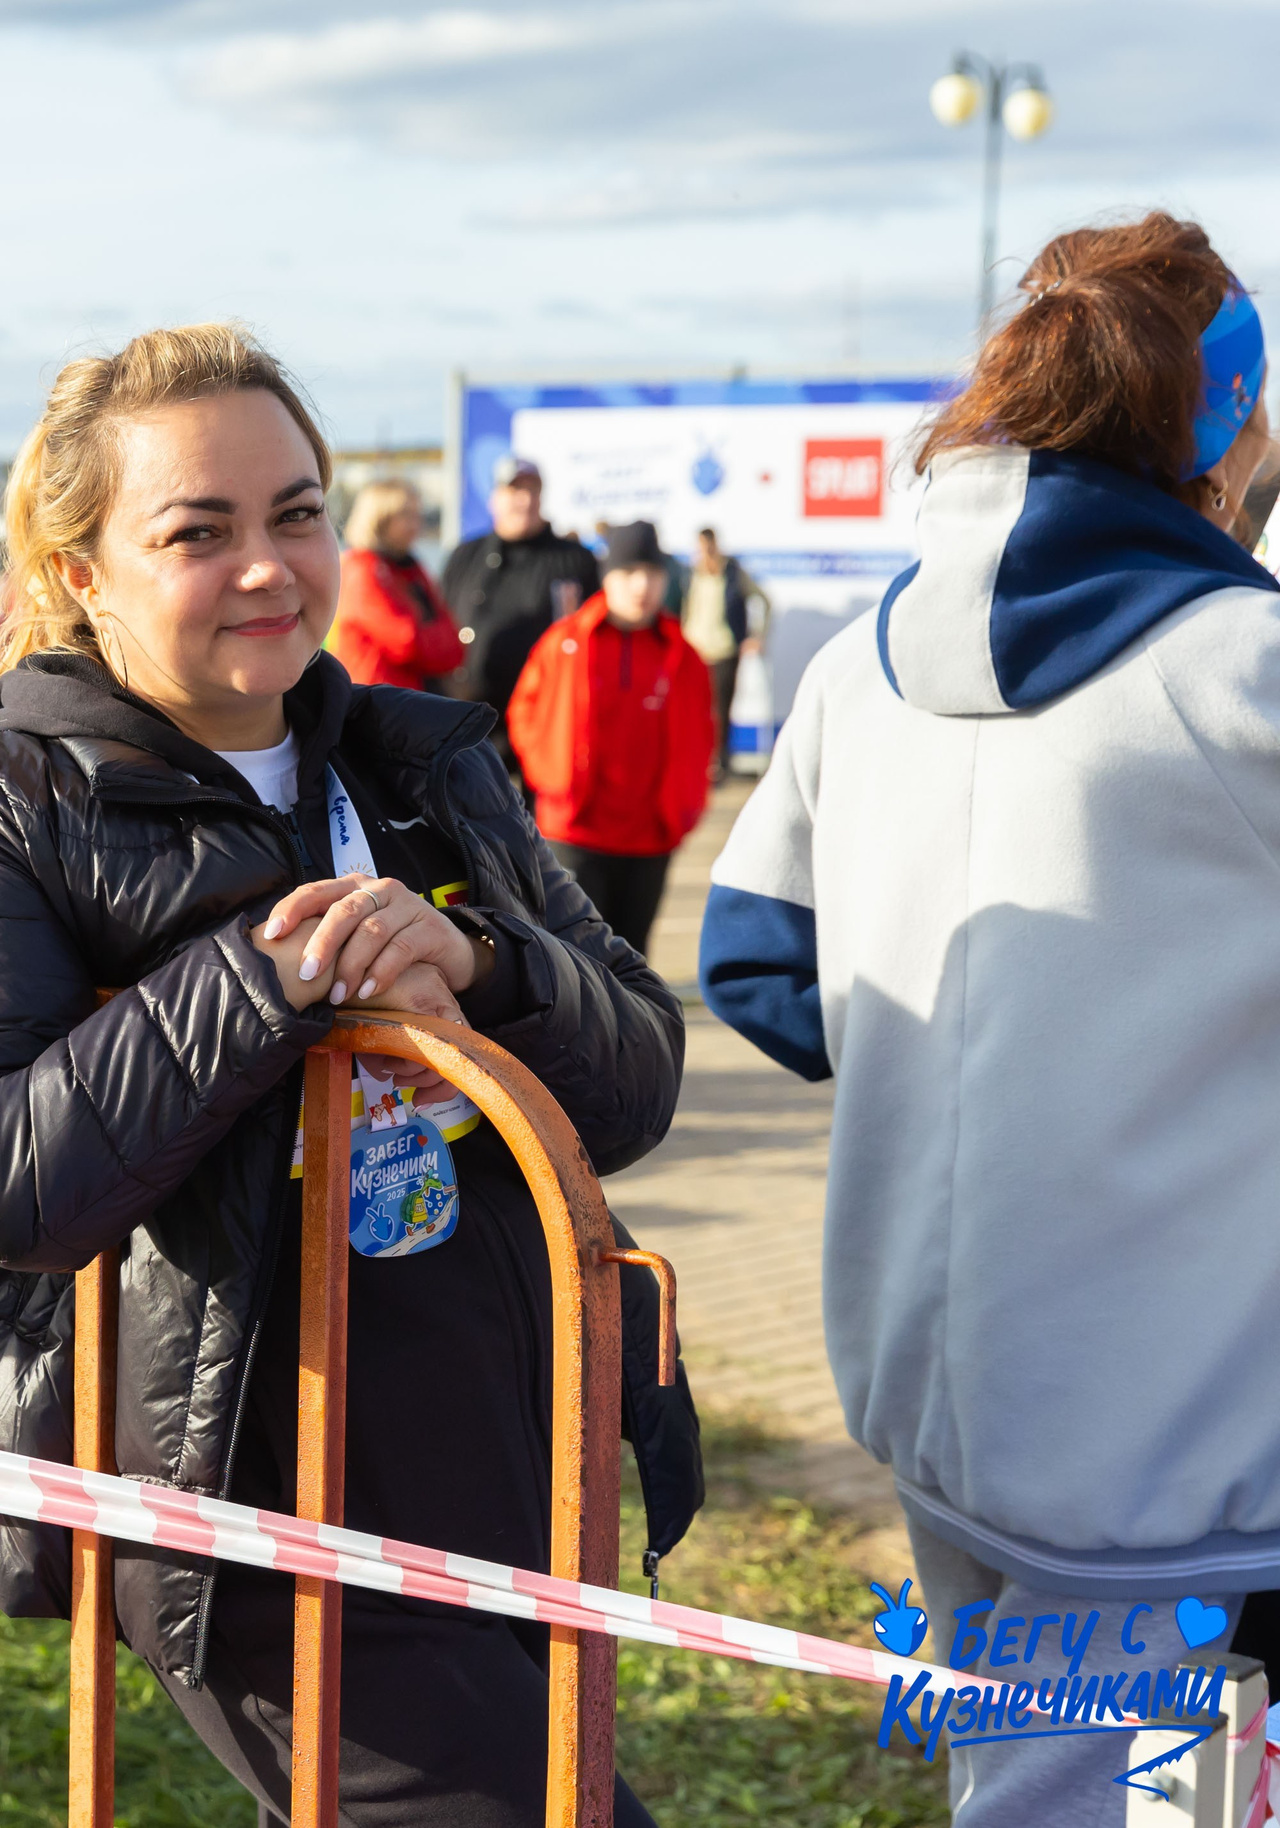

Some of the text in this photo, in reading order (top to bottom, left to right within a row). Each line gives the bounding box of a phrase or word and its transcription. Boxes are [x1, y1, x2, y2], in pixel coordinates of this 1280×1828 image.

[366, 1133, 415, 1166] ЗАБЕГ
[351, 1150, 438, 1200] Кузнечики
[386, 1188, 407, 1202] 2025
